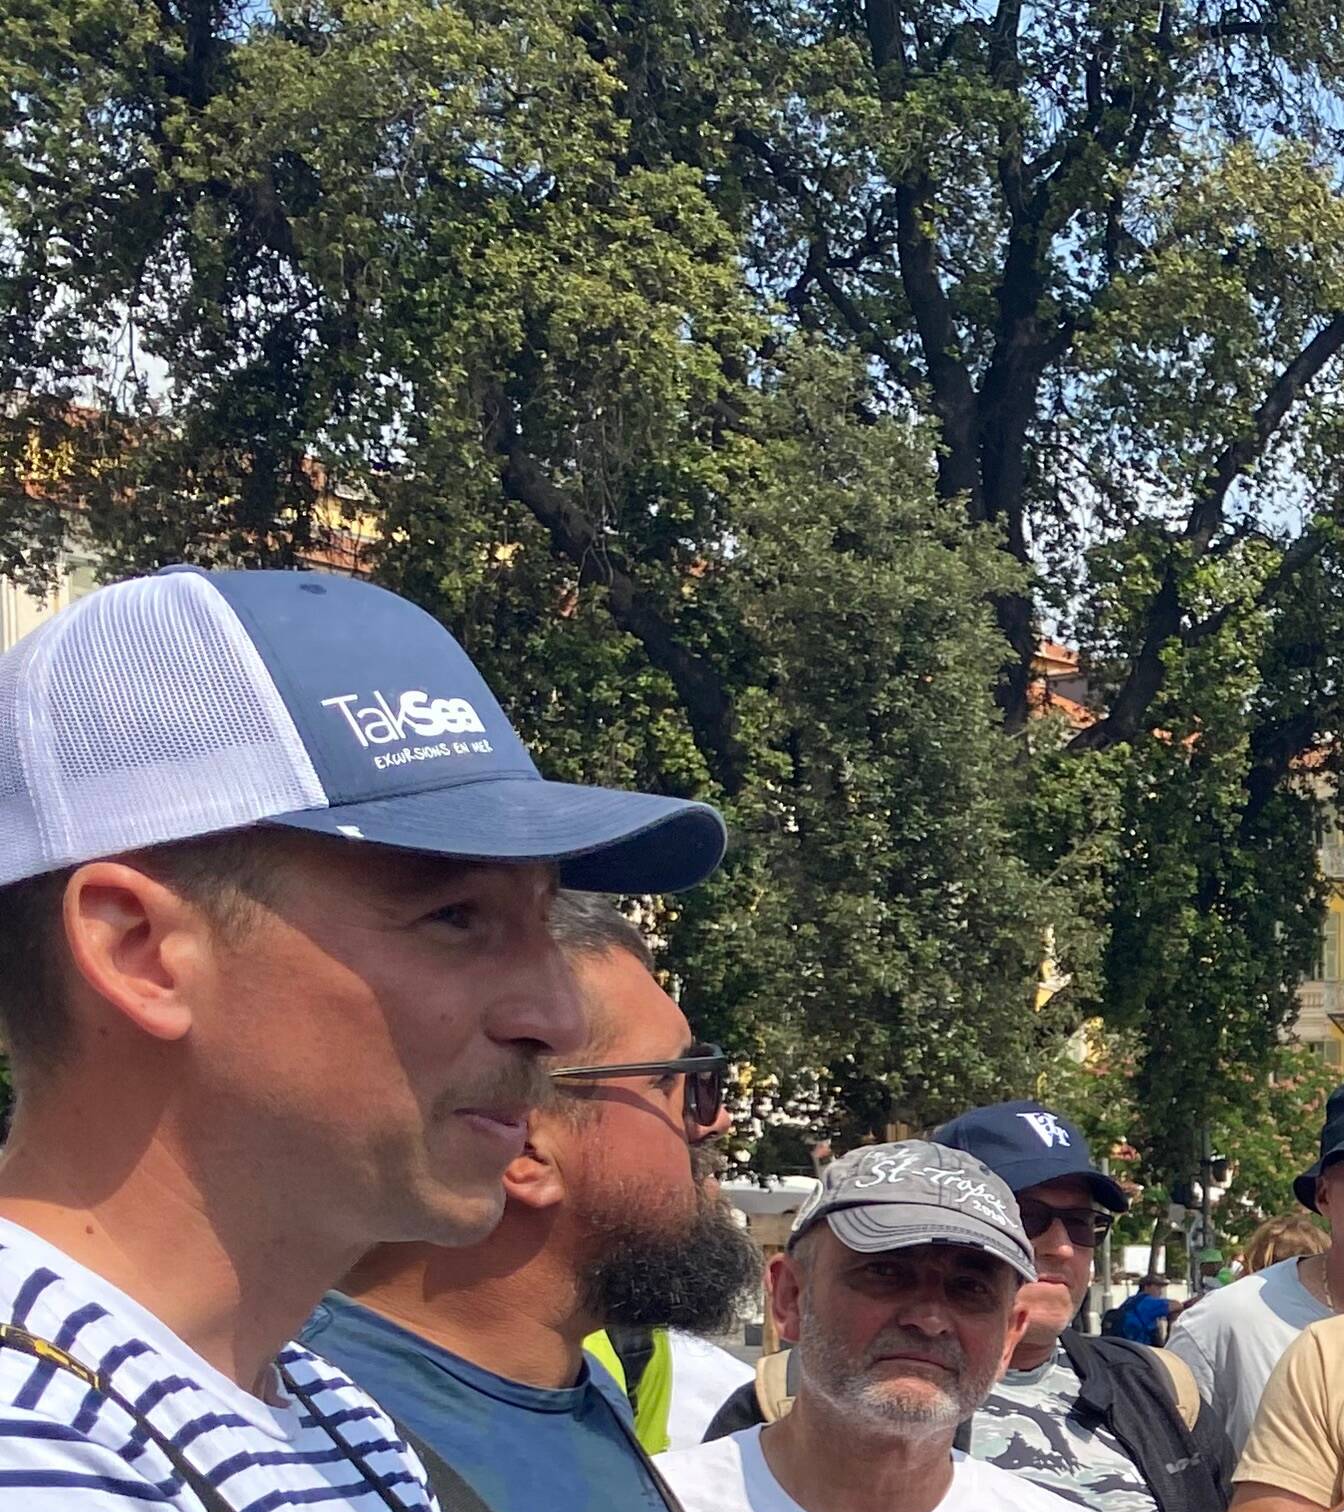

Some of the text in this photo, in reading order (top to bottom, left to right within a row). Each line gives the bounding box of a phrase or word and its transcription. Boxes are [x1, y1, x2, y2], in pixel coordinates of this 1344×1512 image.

[320, 690, 486, 747] TakSea
[374, 738, 494, 769] EXCURSIONS EN MER
